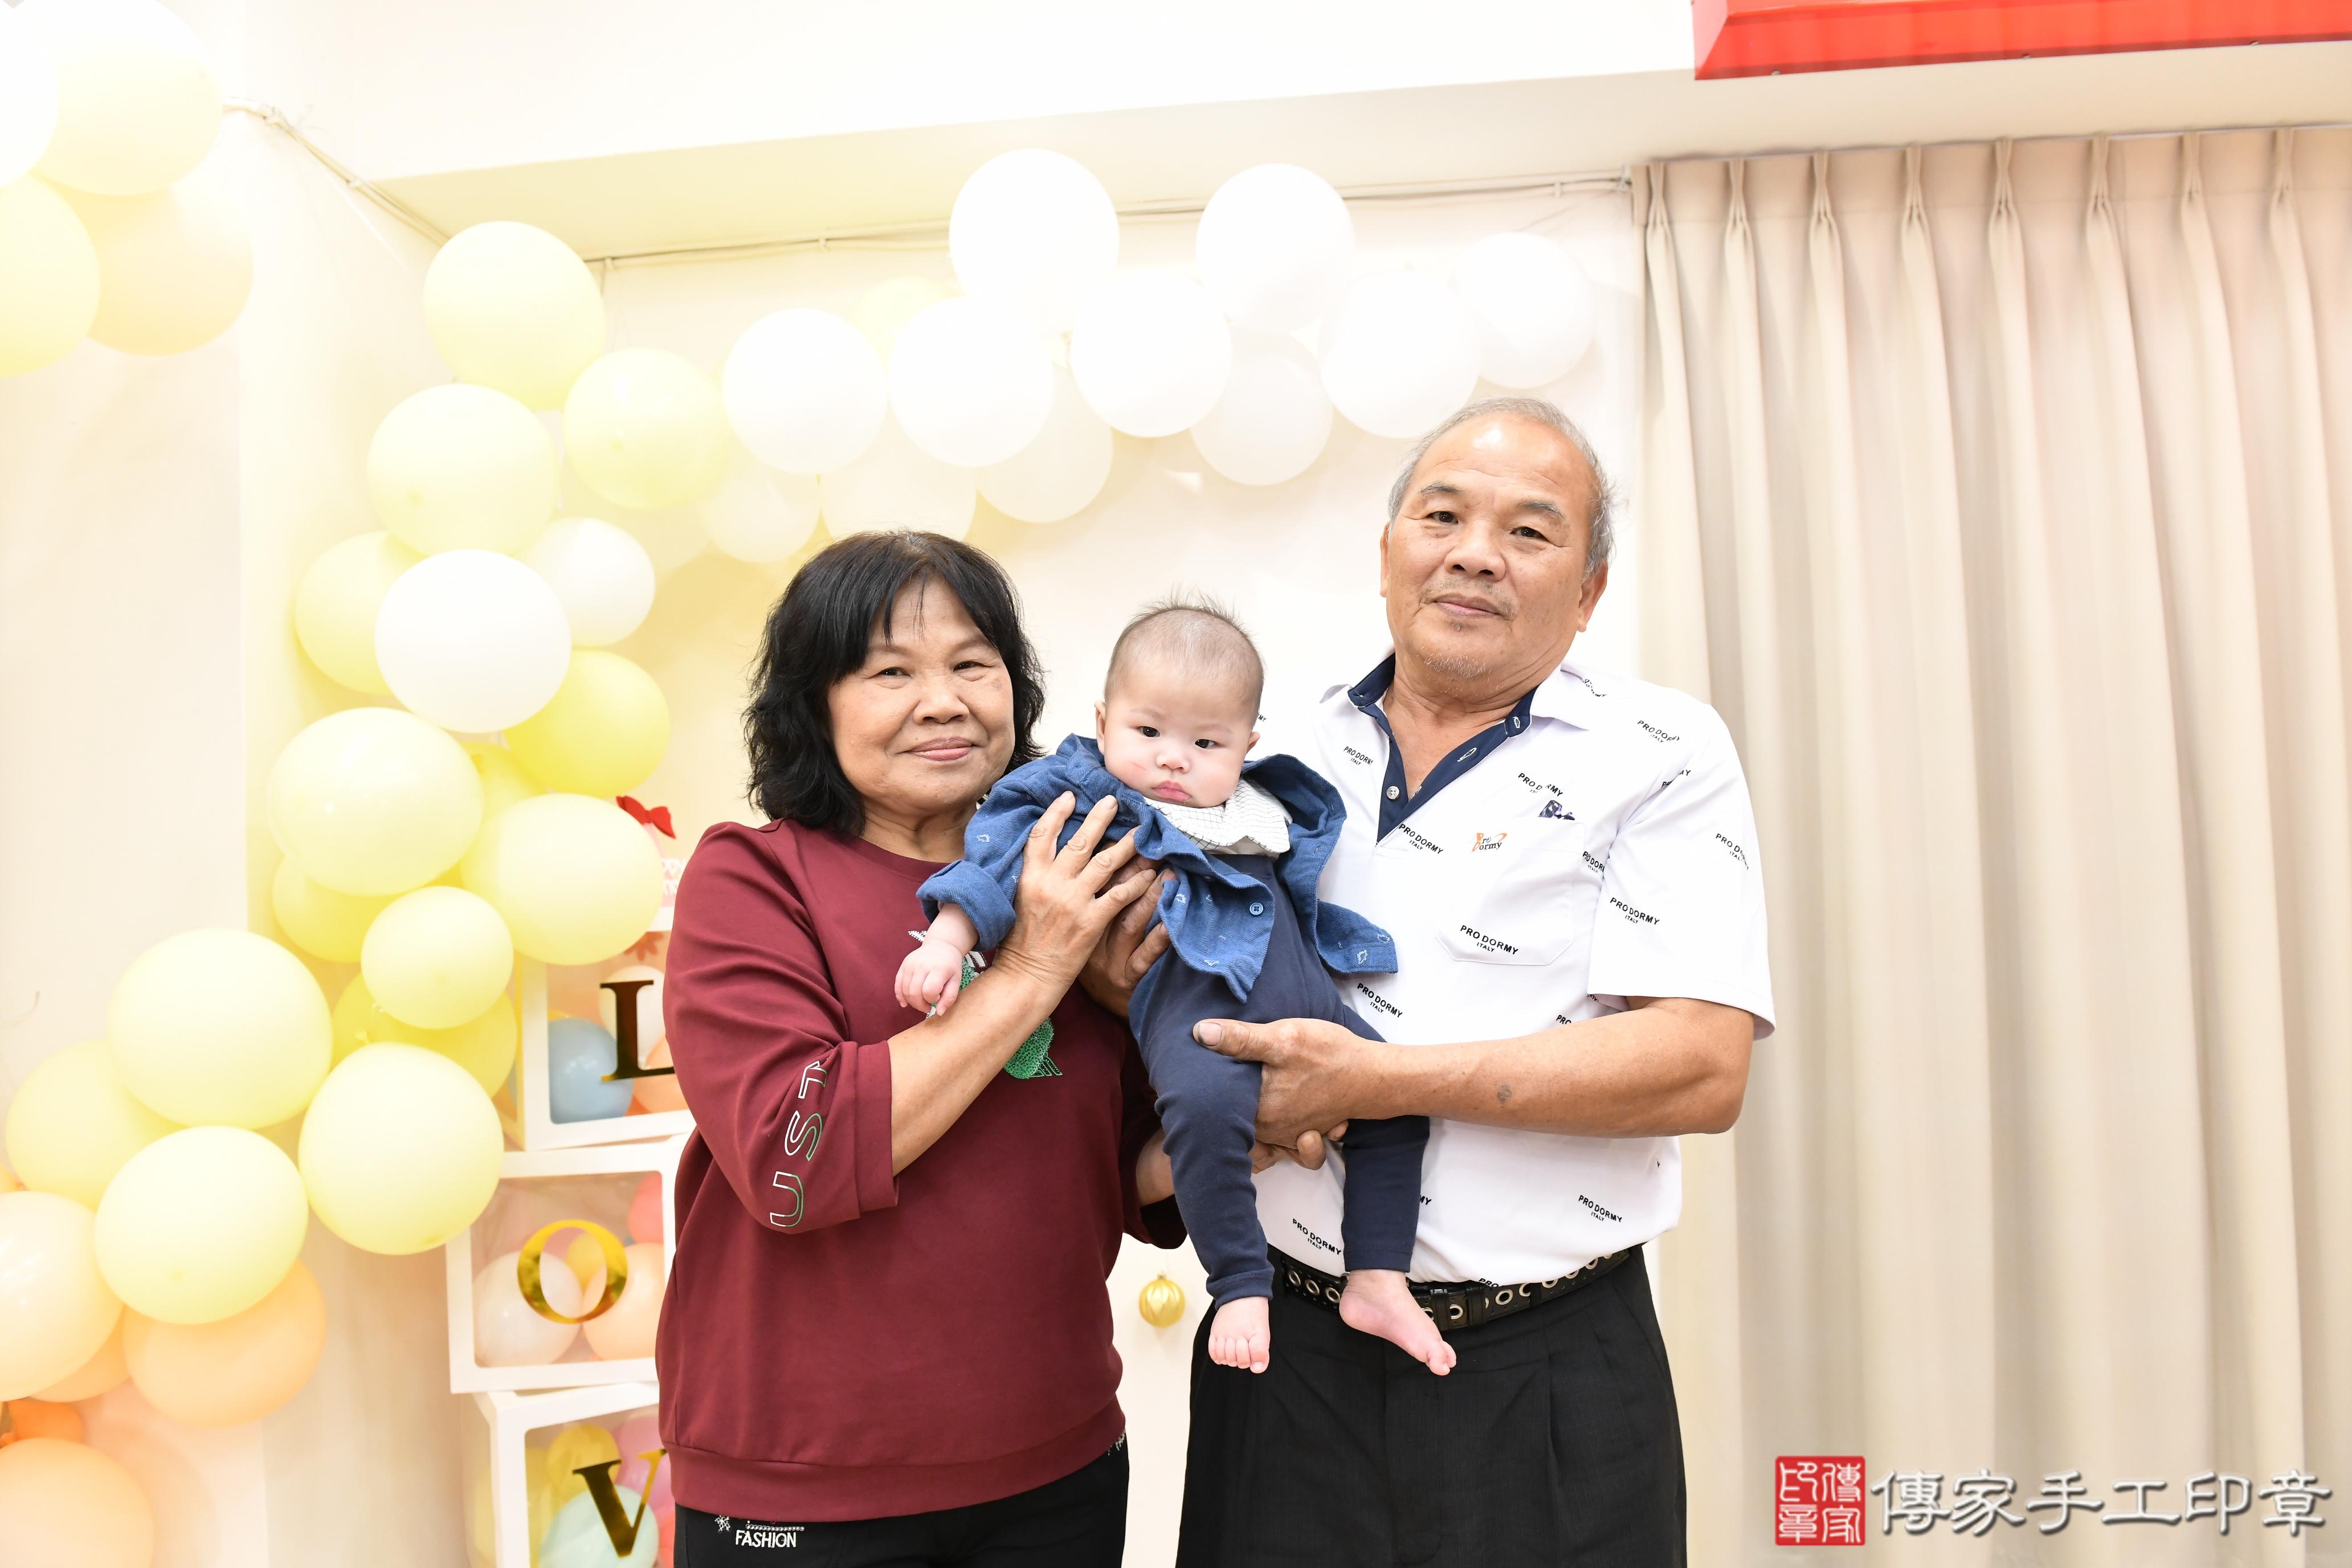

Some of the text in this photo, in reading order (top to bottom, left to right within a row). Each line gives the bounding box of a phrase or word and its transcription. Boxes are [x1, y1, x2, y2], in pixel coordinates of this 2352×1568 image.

[1637, 720, 1655, 733] PRO
[1344, 746, 1356, 756] PRO
[1518, 773, 1536, 787] PRO
[1398, 823, 1444, 854] PRO DORMY
[1409, 840, 1423, 850] ITALY
[1715, 833, 1733, 847] PRO
[1610, 897, 1660, 925] PRO DORMY
[1624, 914, 1639, 924] ITALY
[1460, 925, 1518, 955] PRO DORMY
[1476, 942, 1494, 952] ITALY
[1357, 982, 1403, 1018] PRO DORMY
[1370, 1001, 1384, 1014] ITALY
[1578, 1194, 1623, 1223] PRO DORMY
[1591, 1211, 1604, 1222] ITALY
[1292, 1218, 1342, 1255] PRO DORMY
[1307, 1238, 1322, 1250] ITALY
[735, 1529, 797, 1548] FASHION
